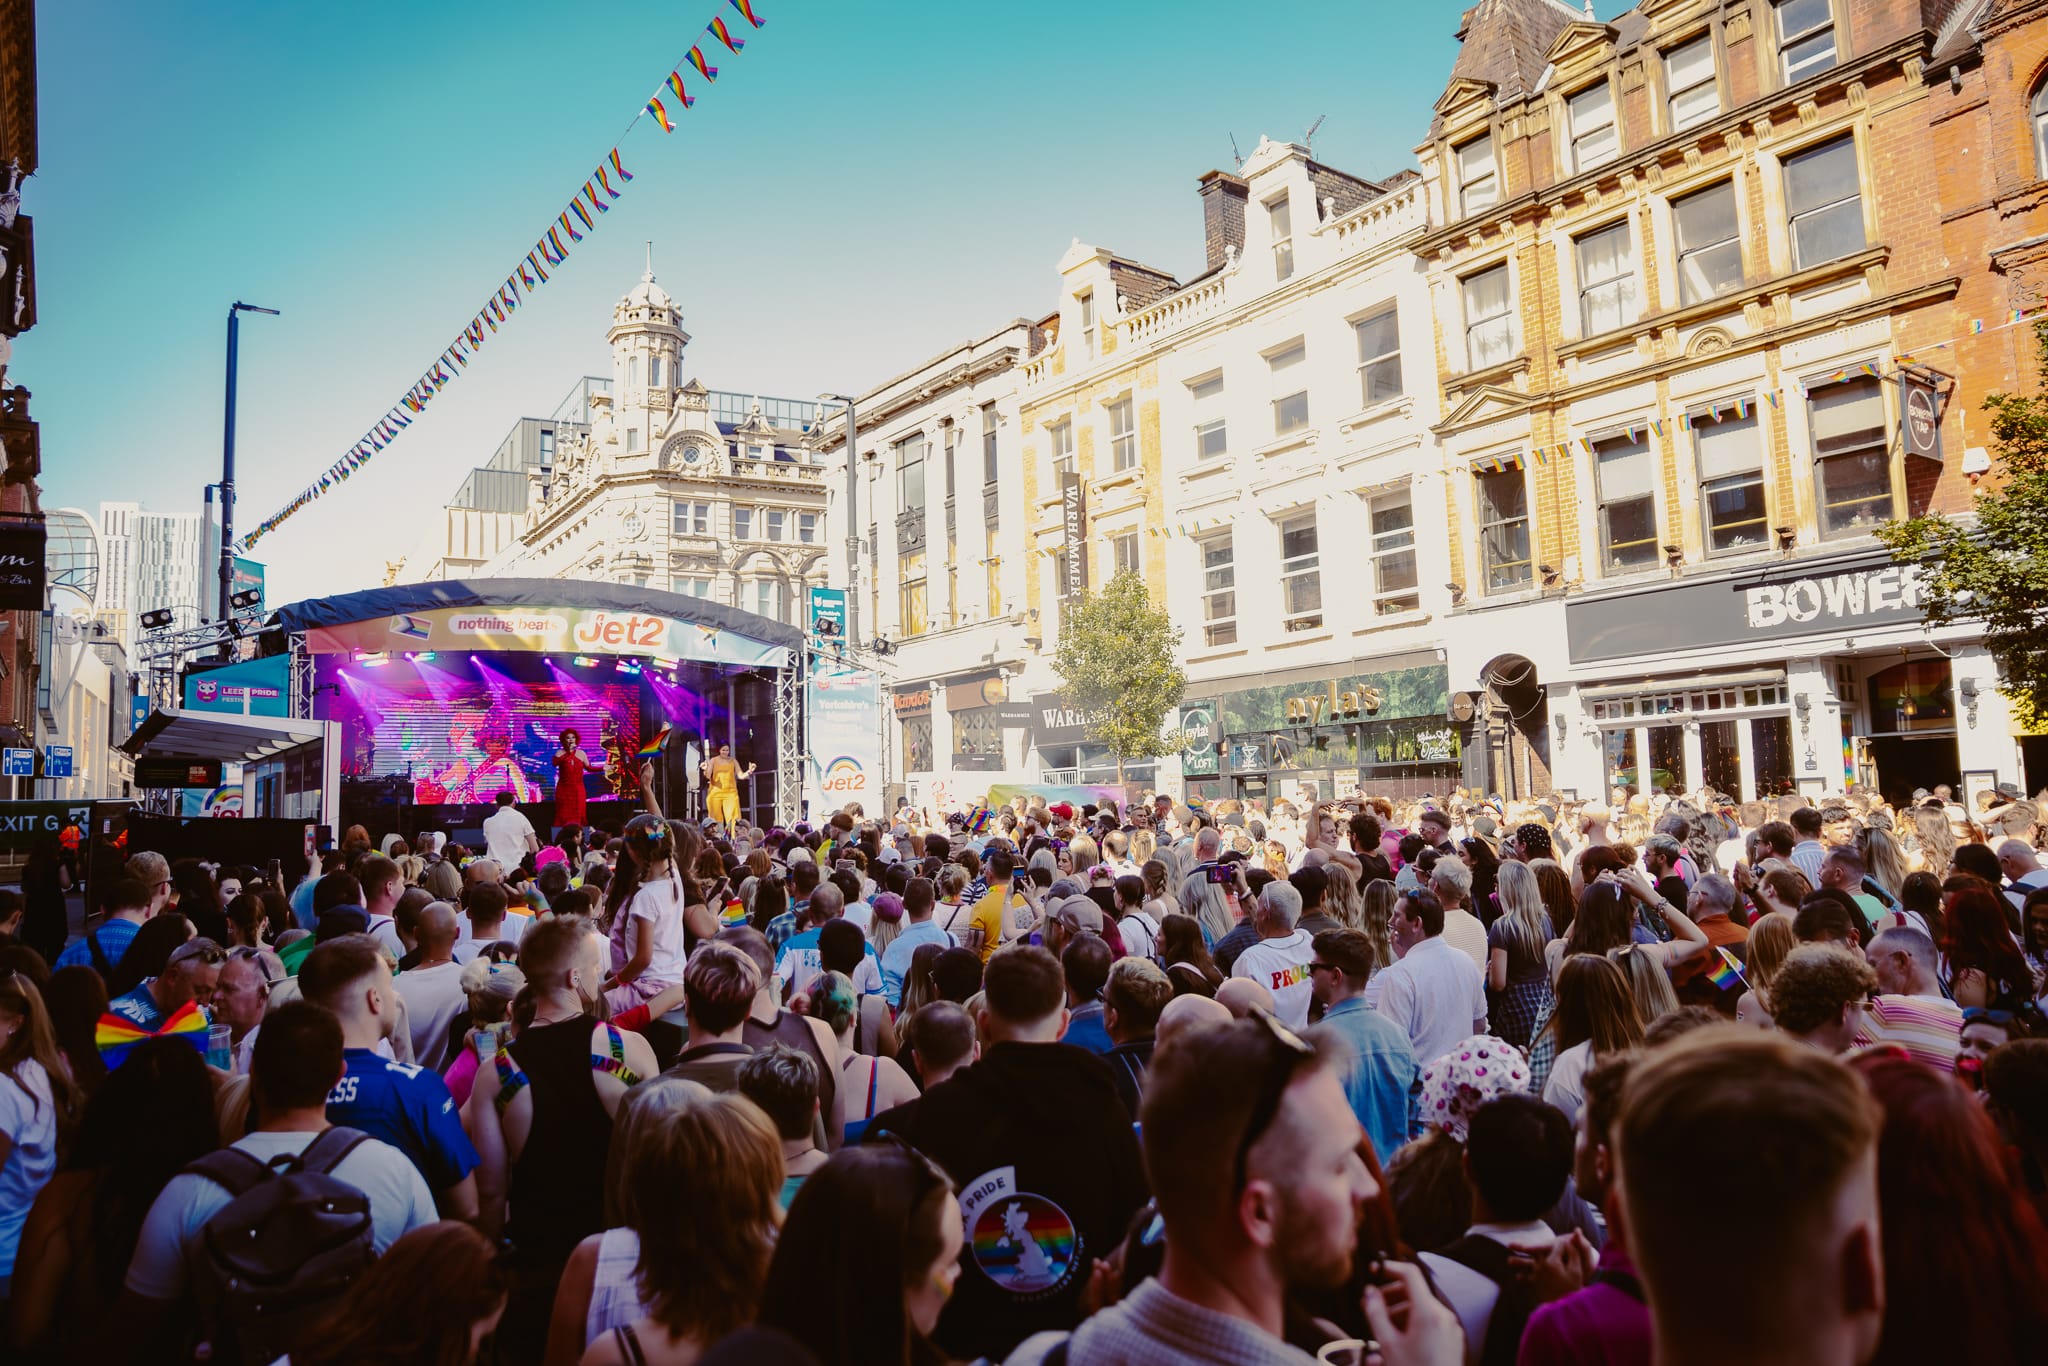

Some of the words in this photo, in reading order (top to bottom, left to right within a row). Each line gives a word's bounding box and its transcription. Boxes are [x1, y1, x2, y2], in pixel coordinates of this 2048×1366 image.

[1065, 484, 1082, 597] WARHAMMER
[1745, 562, 1945, 629] BOWER
[457, 617, 514, 632] nothing
[518, 618, 557, 631] beats
[579, 613, 665, 647] Jet2
[222, 687, 249, 696] LEED
[251, 688, 278, 697] PRIDE
[1286, 679, 1382, 724] nyla's
[1194, 758, 1212, 769] LOFT
[822, 774, 866, 791] Jet2
[1271, 963, 1311, 990] PROU
[965, 1176, 1006, 1210] PRIDE
